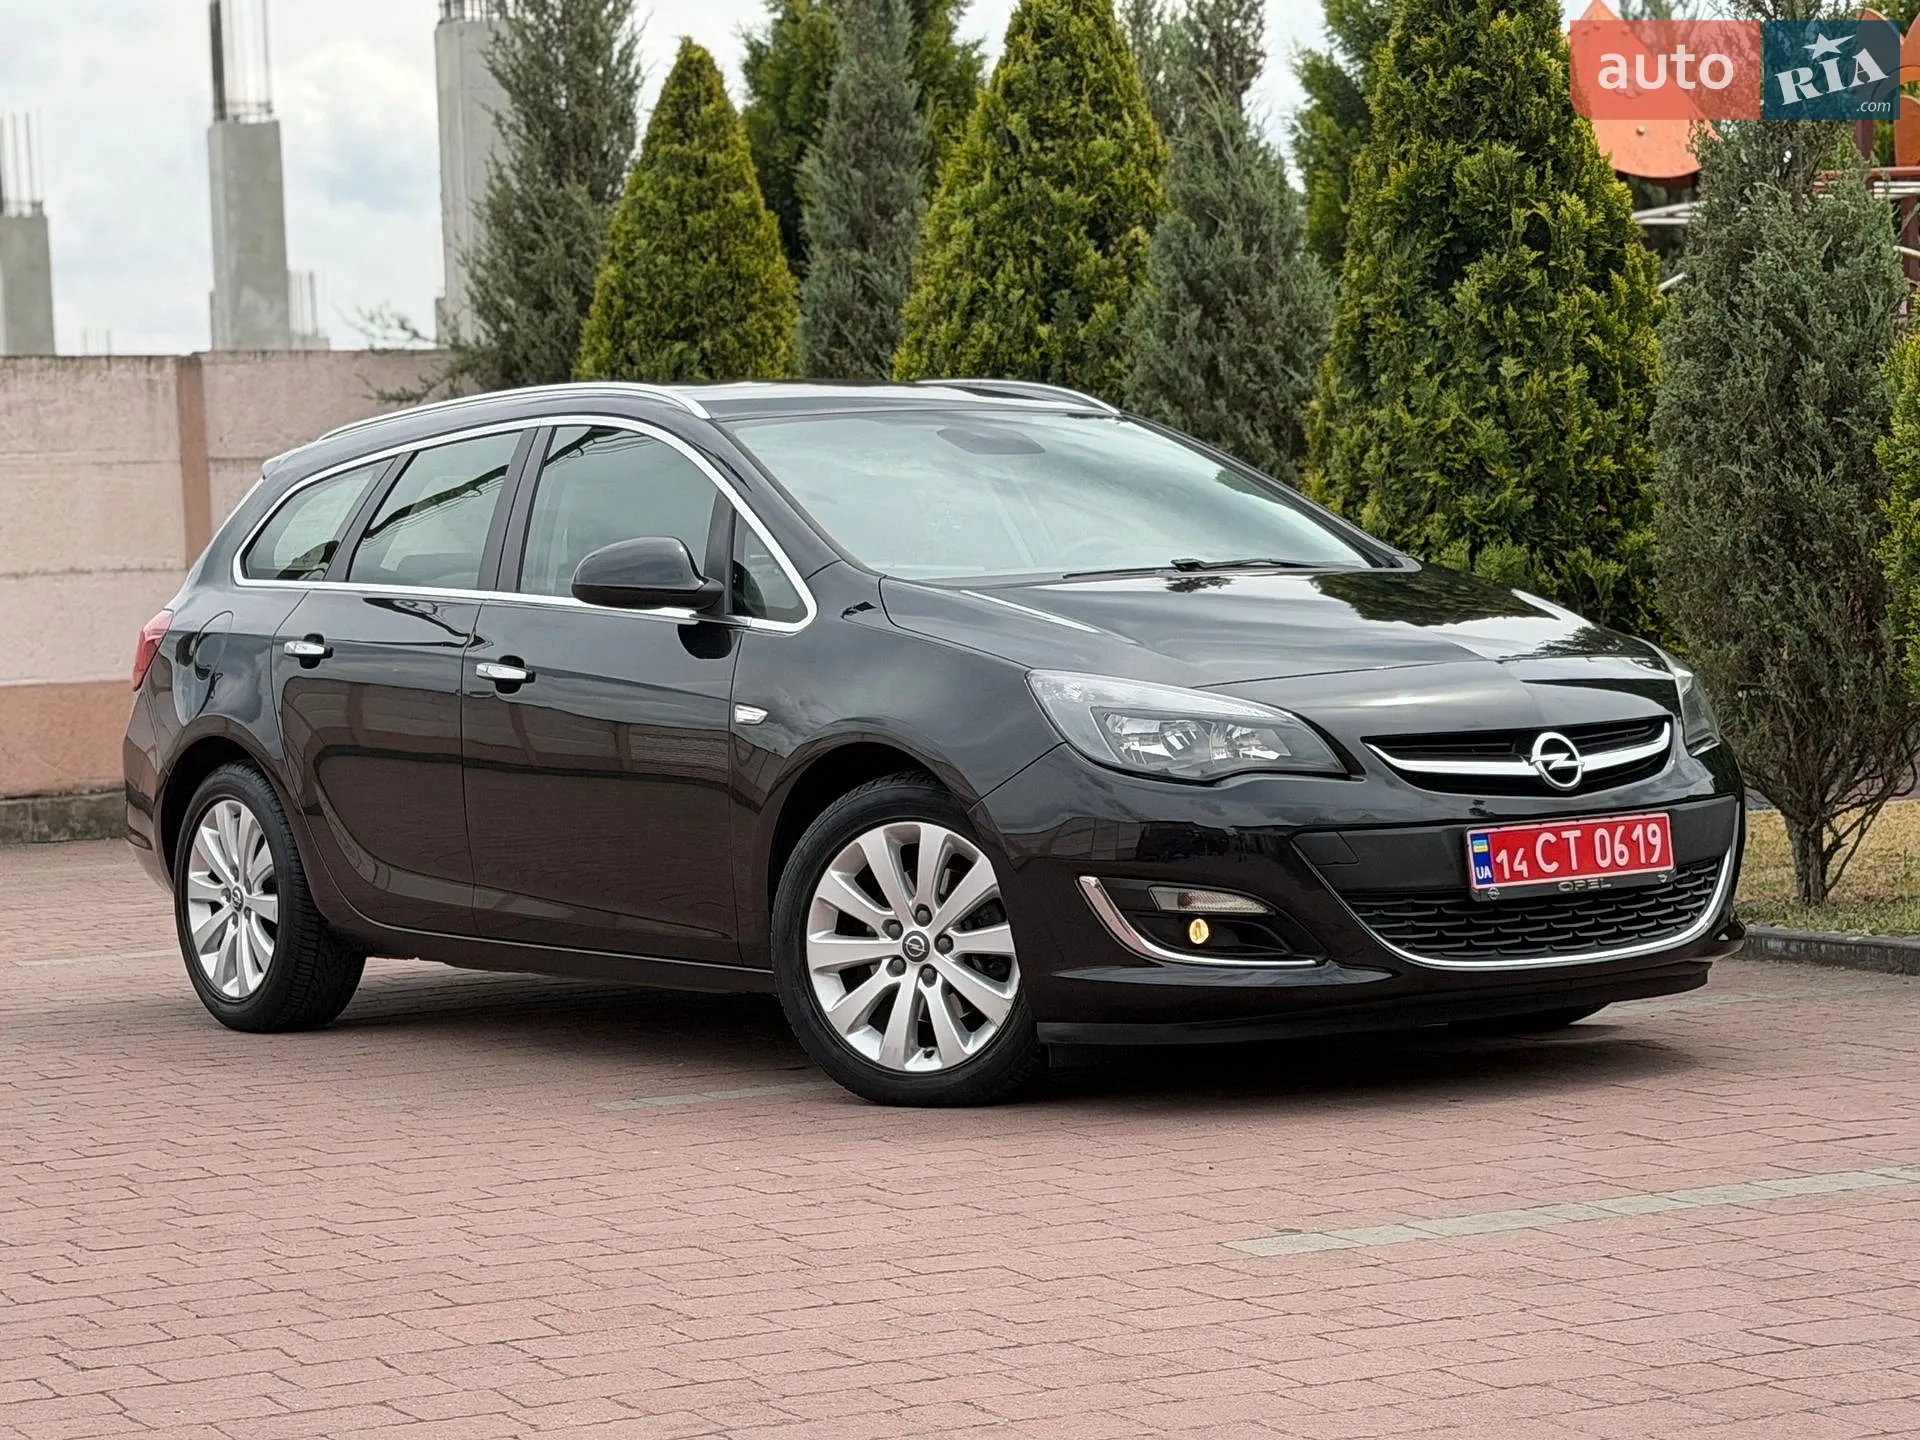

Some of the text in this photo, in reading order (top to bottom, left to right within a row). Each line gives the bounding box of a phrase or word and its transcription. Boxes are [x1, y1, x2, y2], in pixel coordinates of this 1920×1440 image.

[1495, 823, 1662, 880] 14 CT 0619
[1476, 866, 1492, 879] UA
[1557, 878, 1612, 892] OPEL
